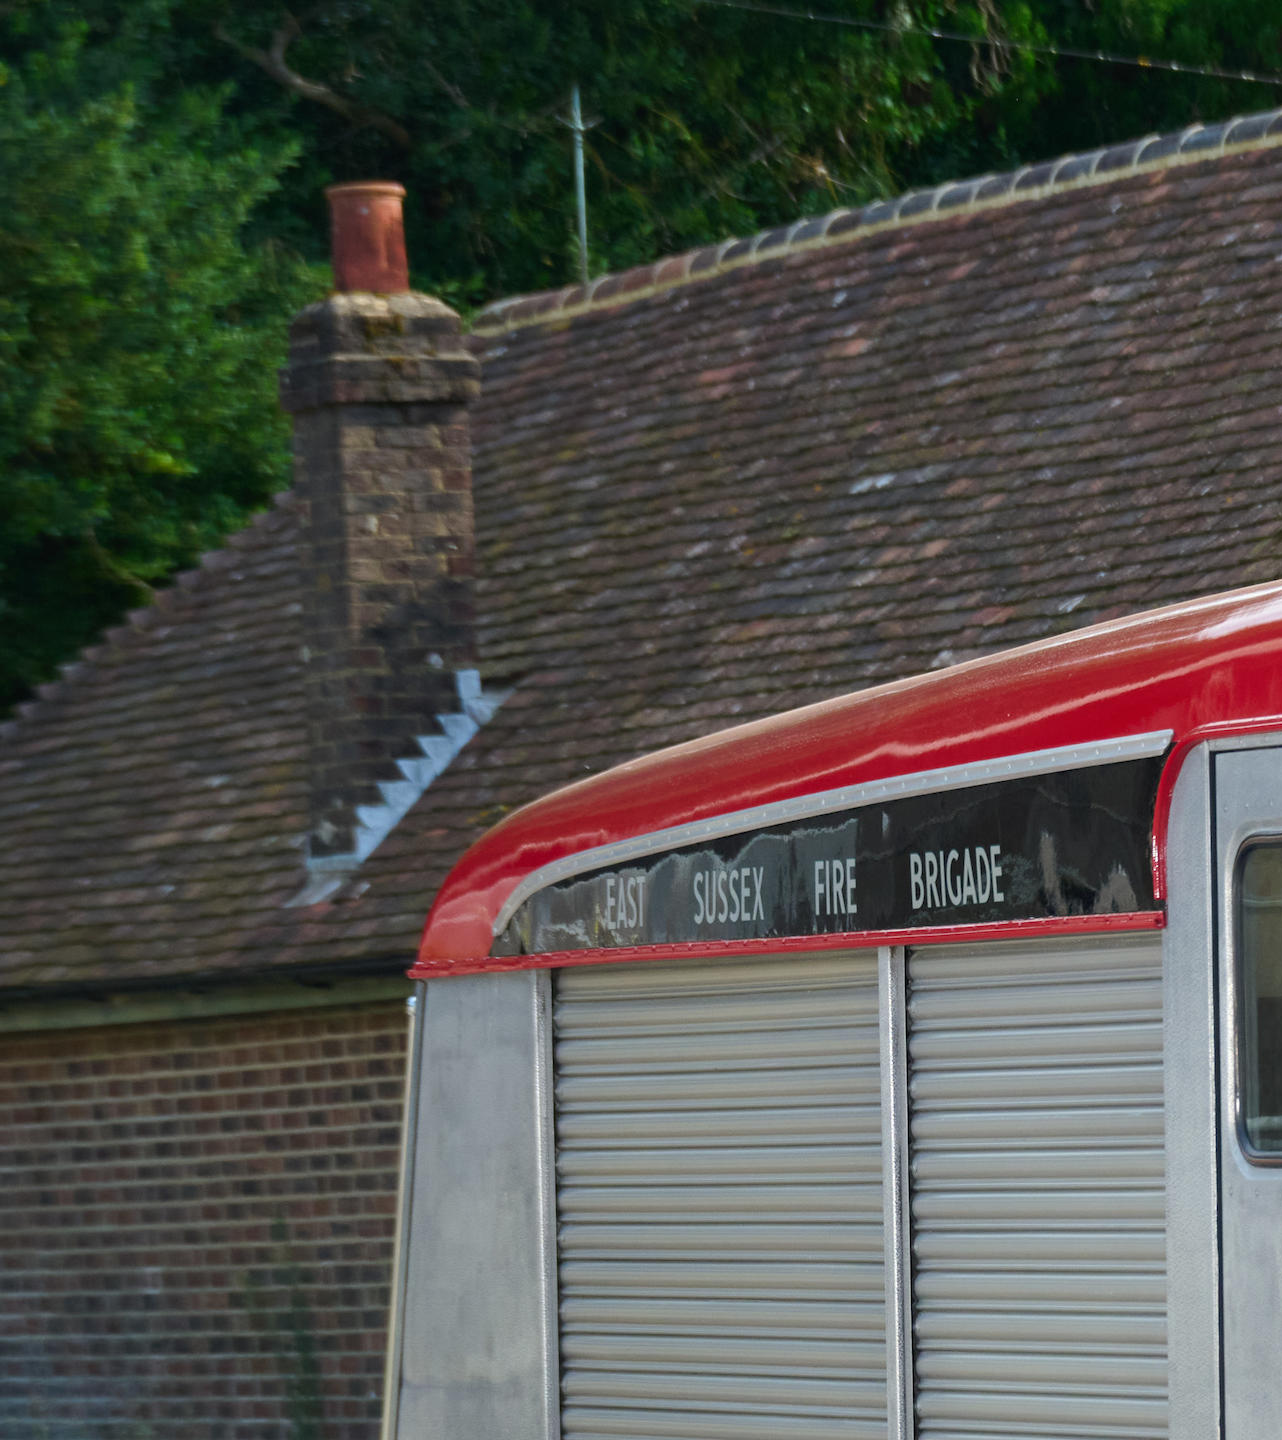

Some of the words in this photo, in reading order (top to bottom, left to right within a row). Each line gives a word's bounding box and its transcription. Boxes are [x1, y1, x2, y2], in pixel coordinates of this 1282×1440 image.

[606, 876, 645, 929] EAST
[693, 867, 765, 924] SUSSEX
[815, 858, 857, 915] FIRE
[910, 845, 1004, 909] BRIGADE
